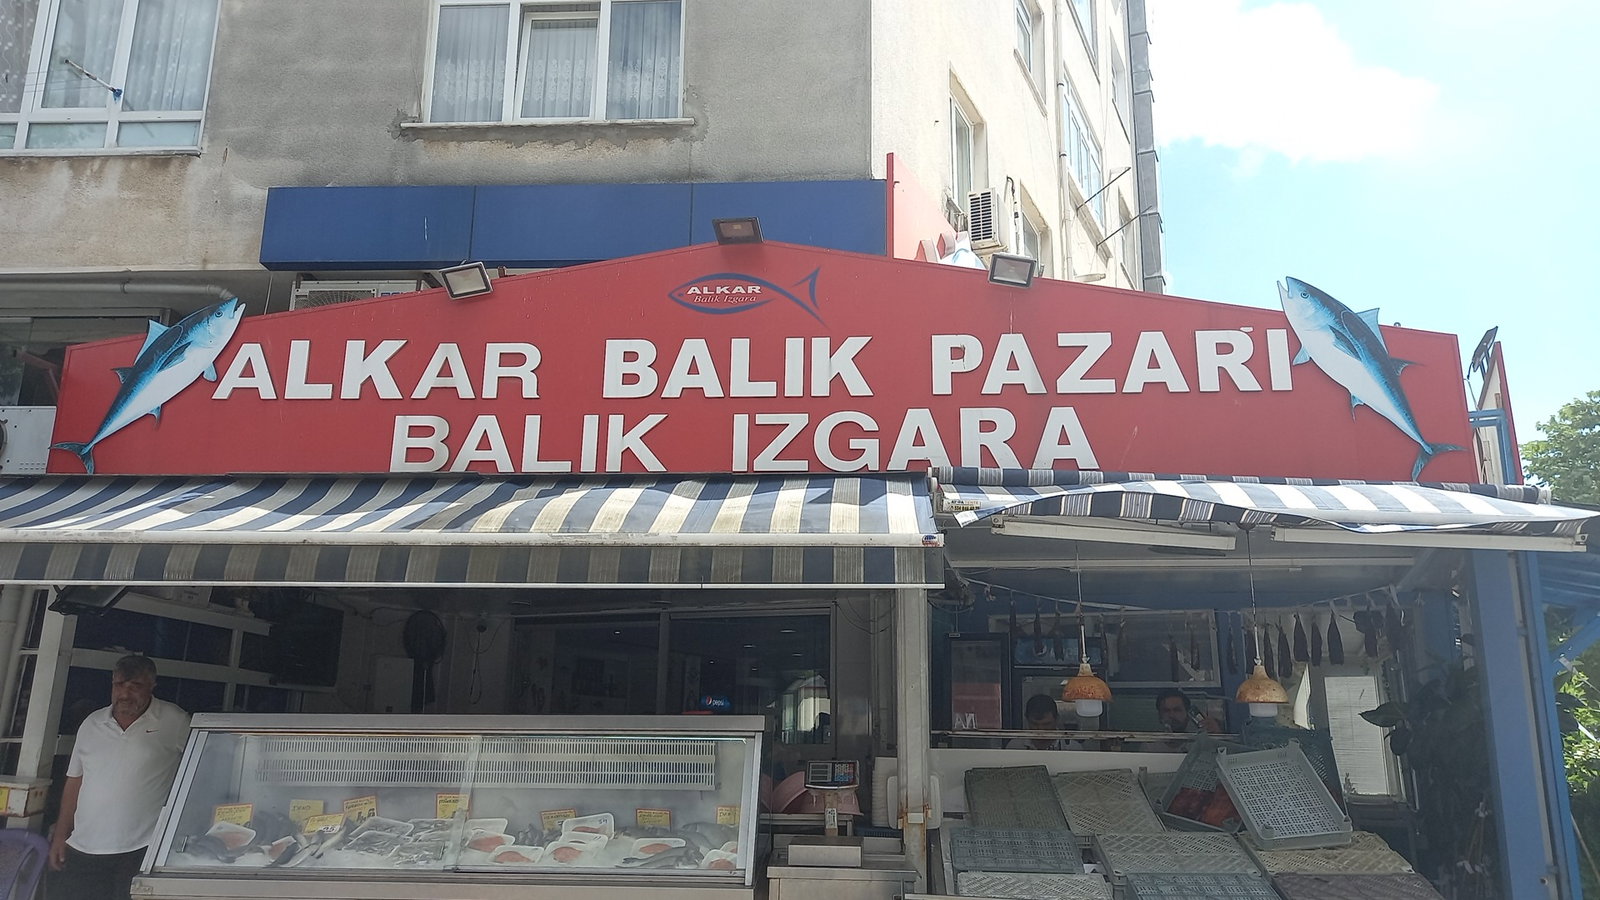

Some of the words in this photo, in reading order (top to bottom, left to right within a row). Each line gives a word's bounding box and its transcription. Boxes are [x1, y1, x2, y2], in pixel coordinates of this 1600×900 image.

[687, 286, 761, 294] ALKAR
[211, 339, 542, 400] ALKAR
[602, 336, 875, 399] BALIK
[931, 328, 1294, 396] PAZARI
[389, 414, 668, 473] BALIK
[732, 406, 1101, 473] IZGARA
